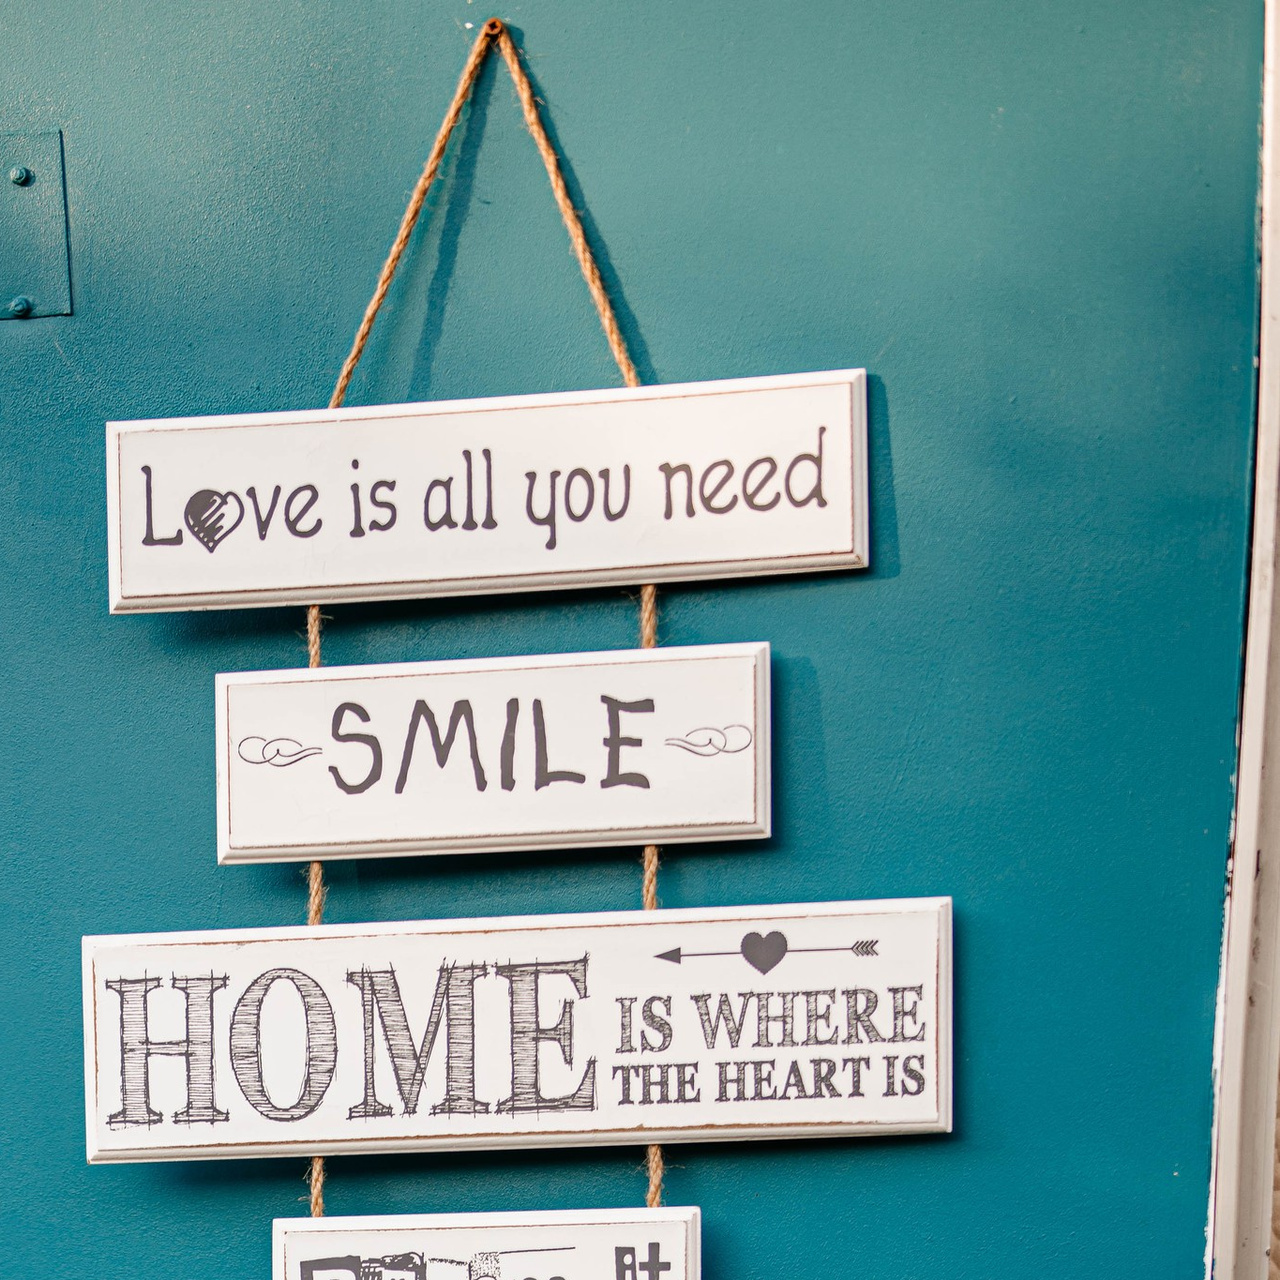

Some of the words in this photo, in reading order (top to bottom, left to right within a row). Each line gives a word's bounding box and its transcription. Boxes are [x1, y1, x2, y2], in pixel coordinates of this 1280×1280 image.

[141, 466, 322, 553] Love
[349, 459, 397, 538] is
[423, 448, 498, 531] all
[524, 464, 631, 549] you
[658, 426, 827, 520] need
[328, 694, 655, 795] SMILE
[105, 953, 598, 1130] HOME
[615, 995, 673, 1054] IS
[690, 985, 926, 1052] WHERE
[613, 1061, 701, 1106] THE
[714, 1056, 871, 1103] HEART
[882, 1054, 925, 1097] IS
